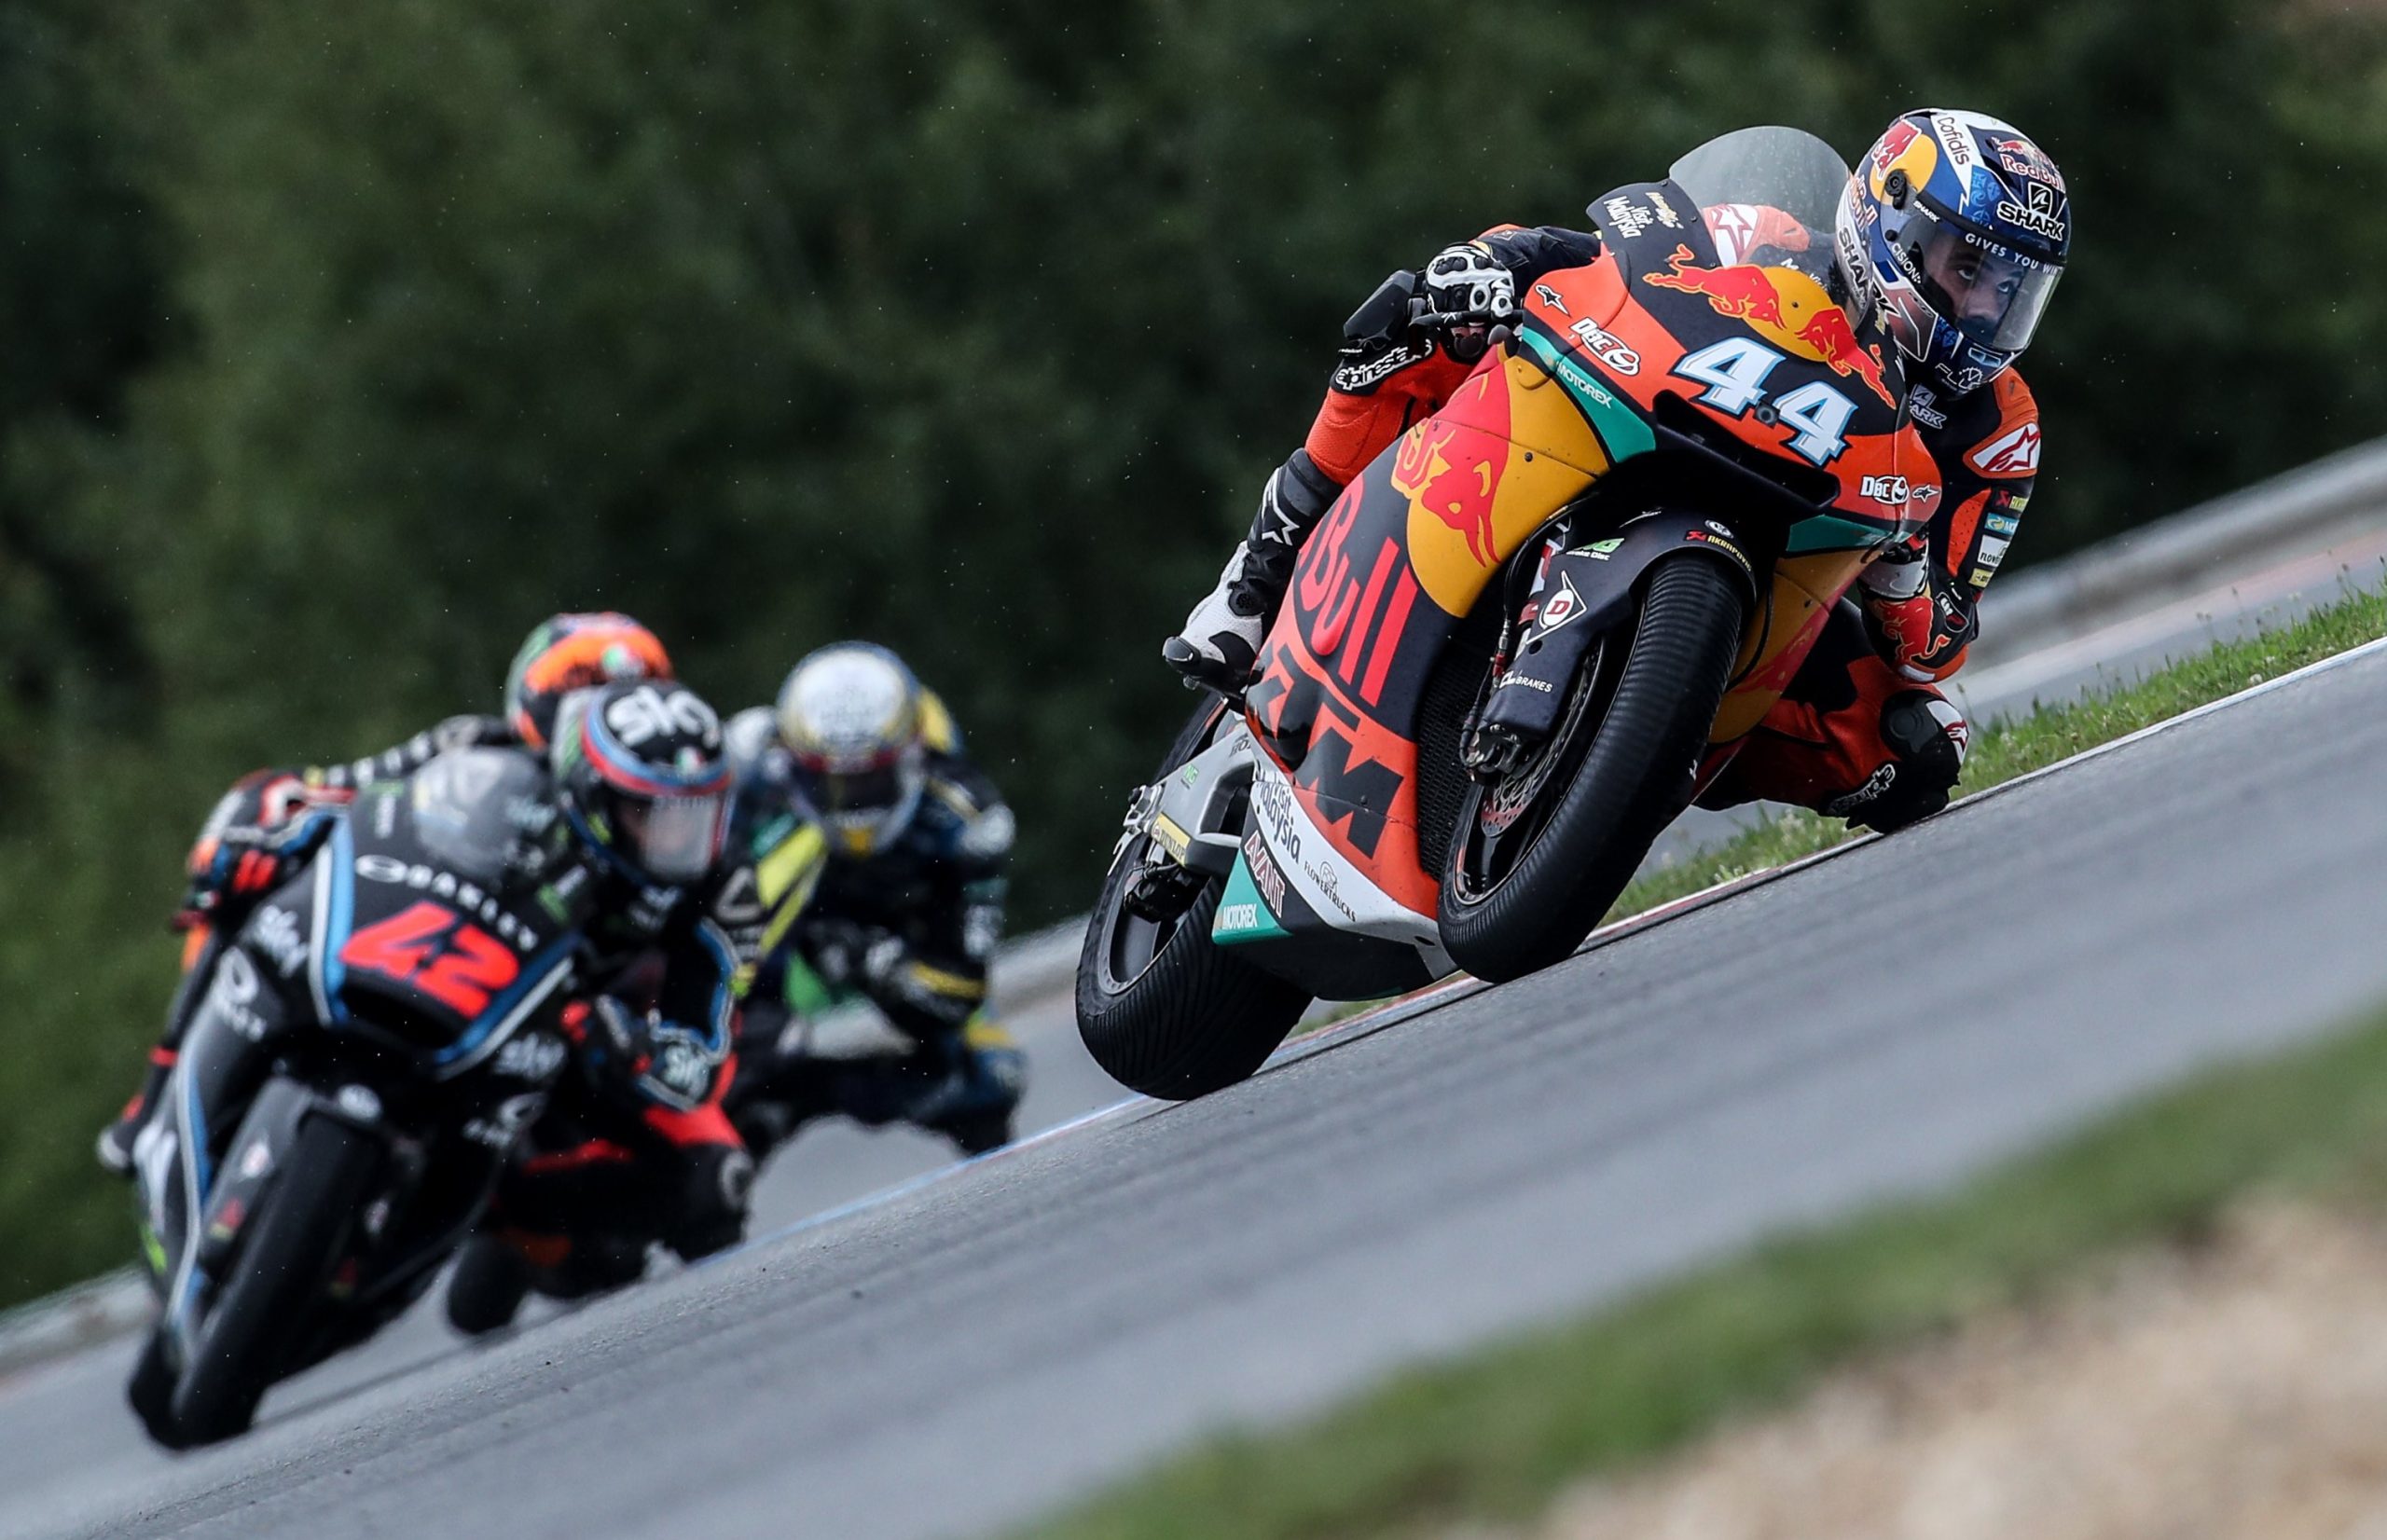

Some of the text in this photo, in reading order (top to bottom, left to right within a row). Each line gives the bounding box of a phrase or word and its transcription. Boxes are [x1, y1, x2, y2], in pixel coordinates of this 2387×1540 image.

[1937, 117, 1970, 166] Cofidis
[1912, 199, 1940, 224] SHARK
[1997, 200, 2066, 241] SHARK
[1891, 242, 1920, 282] CISION
[1965, 233, 2008, 257] GIVES
[2014, 252, 2039, 269] YOU
[1568, 316, 1615, 351] DBC
[1556, 360, 1613, 410] MOTOREX
[1674, 337, 1859, 466] 44
[1909, 403, 1947, 430] ARK
[1515, 676, 1553, 693] BRAKES
[1247, 641, 1404, 859] KTM
[1244, 829, 1286, 919] AVANT
[1304, 859, 1357, 923] FLOWERTRUCKS
[1221, 902, 1258, 930] MOTOREX
[338, 900, 520, 1021] 42
